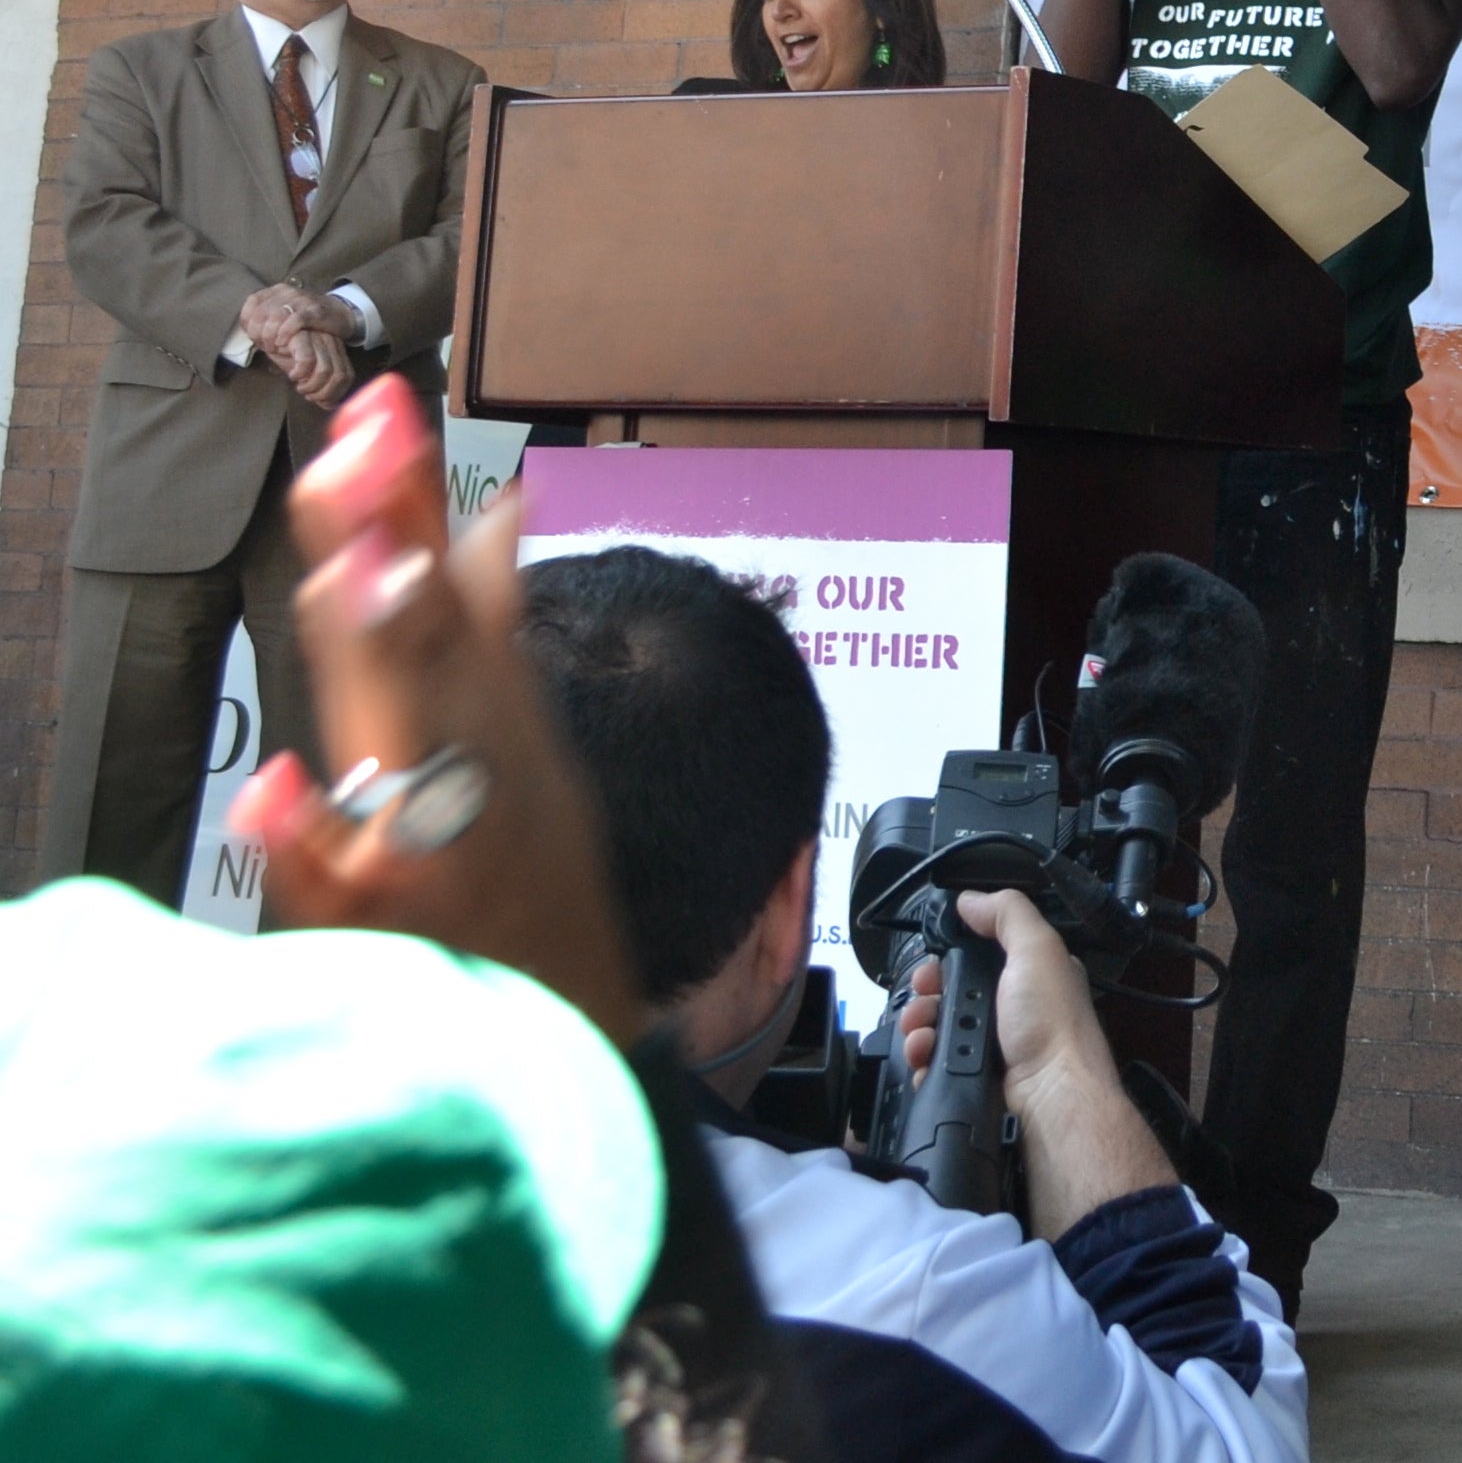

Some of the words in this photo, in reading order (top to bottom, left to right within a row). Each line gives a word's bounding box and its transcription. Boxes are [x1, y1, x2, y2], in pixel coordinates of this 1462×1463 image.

[1158, 2, 1205, 24] OUR
[1207, 5, 1324, 29] FUTURE
[1131, 34, 1295, 60] TOGETHER
[817, 575, 905, 611] OUR
